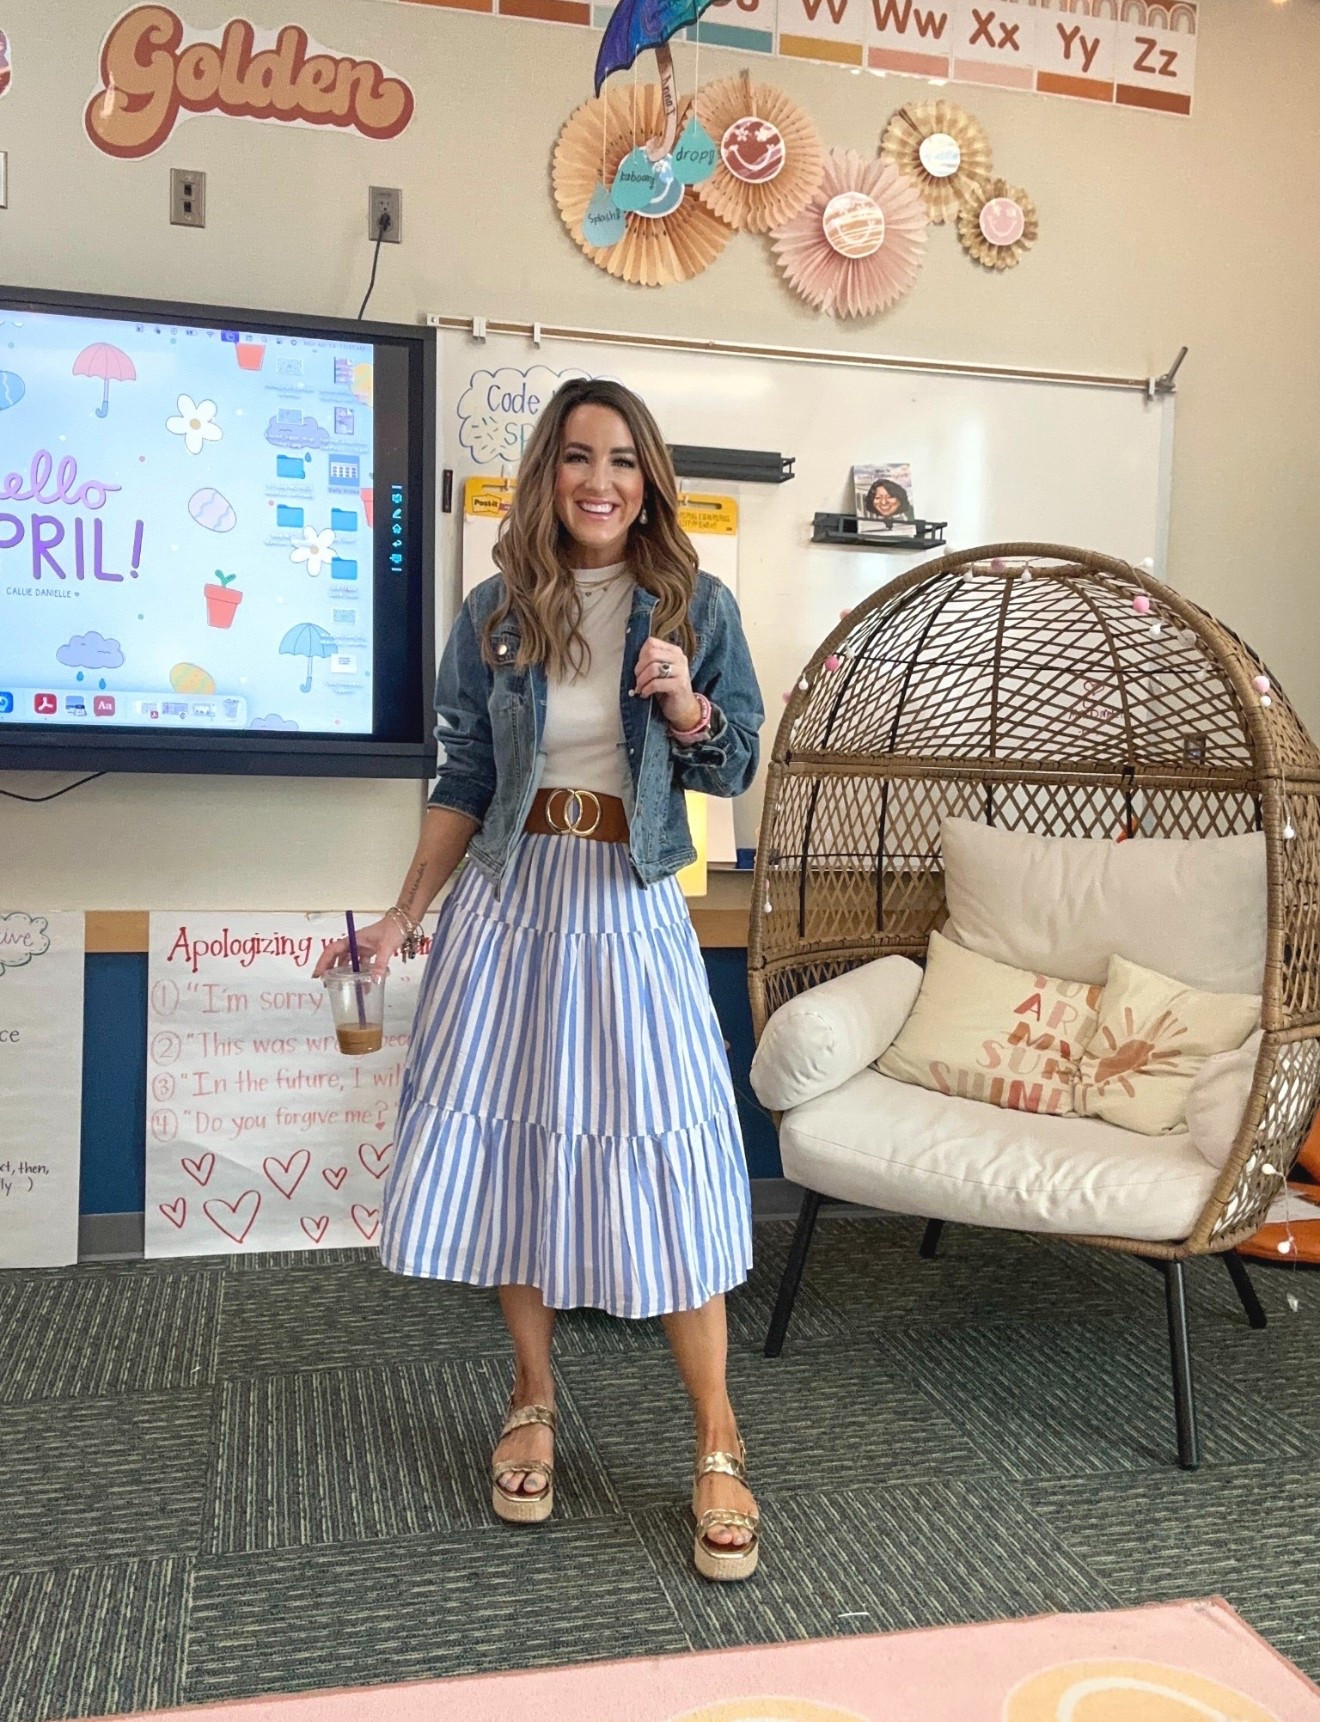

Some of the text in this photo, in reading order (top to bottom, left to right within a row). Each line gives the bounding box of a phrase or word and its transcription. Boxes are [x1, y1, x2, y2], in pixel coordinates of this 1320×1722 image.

[873, 0, 948, 39] Ww
[969, 9, 1020, 51] Xx
[1057, 22, 1100, 72] Yy
[1133, 36, 1179, 77] Zz
[86, 4, 414, 159] Golden
[487, 382, 541, 415] Code
[503, 422, 537, 457] SP
[0, 449, 122, 510] ello
[474, 498, 499, 508] Post-it
[0, 512, 144, 582] PRIL!
[6, 586, 72, 598] CALLIE DANIELLE
[167, 926, 314, 973] Apologizing
[260, 990, 324, 1014] sorry
[253, 1035, 296, 1054] was
[234, 1069, 268, 1092] the
[276, 1067, 345, 1092] future,
[348, 1066, 361, 1089] I
[373, 1063, 401, 1087] wil
[231, 1115, 267, 1141] you
[275, 1106, 339, 1132] forgive
[18, 1161, 49, 1175] then,
